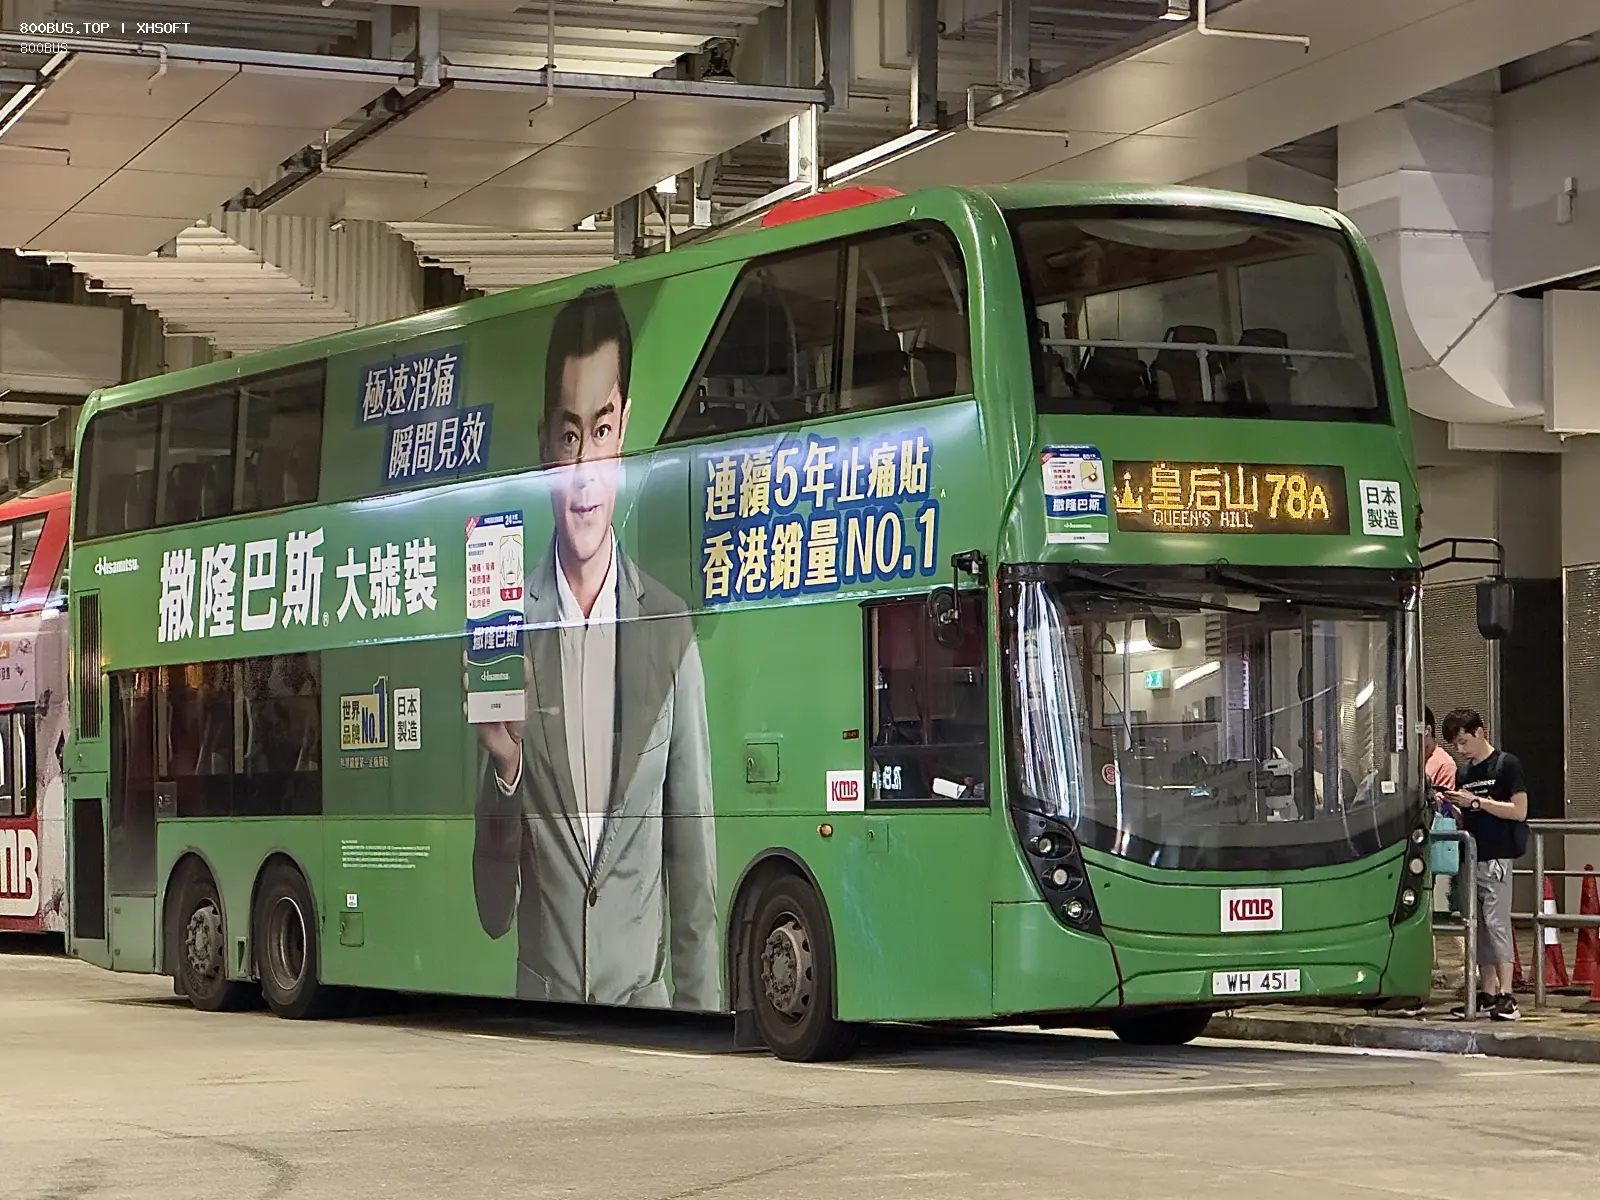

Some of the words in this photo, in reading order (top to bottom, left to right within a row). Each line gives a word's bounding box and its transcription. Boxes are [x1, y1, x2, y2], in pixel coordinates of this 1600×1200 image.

[362, 353, 458, 422] 極速消痛
[388, 411, 486, 479] 瞬間見效
[1147, 463, 1258, 512] 皇后山
[1265, 474, 1330, 519] 78A
[1366, 487, 1396, 506] 日本
[1152, 509, 1211, 527] QUEEN'S
[1220, 511, 1254, 529] HILL
[1367, 509, 1399, 530] 製造
[336, 537, 437, 623] 大號裝
[342, 700, 360, 721] 世界
[397, 695, 417, 716] 日本
[342, 723, 360, 745] 品牌
[397, 719, 418, 742] 製造
[831, 780, 859, 801] KMB
[0, 829, 40, 917] MB
[1229, 899, 1274, 921] KMB
[1226, 973, 1251, 992] WH
[1260, 972, 1287, 991] 451
